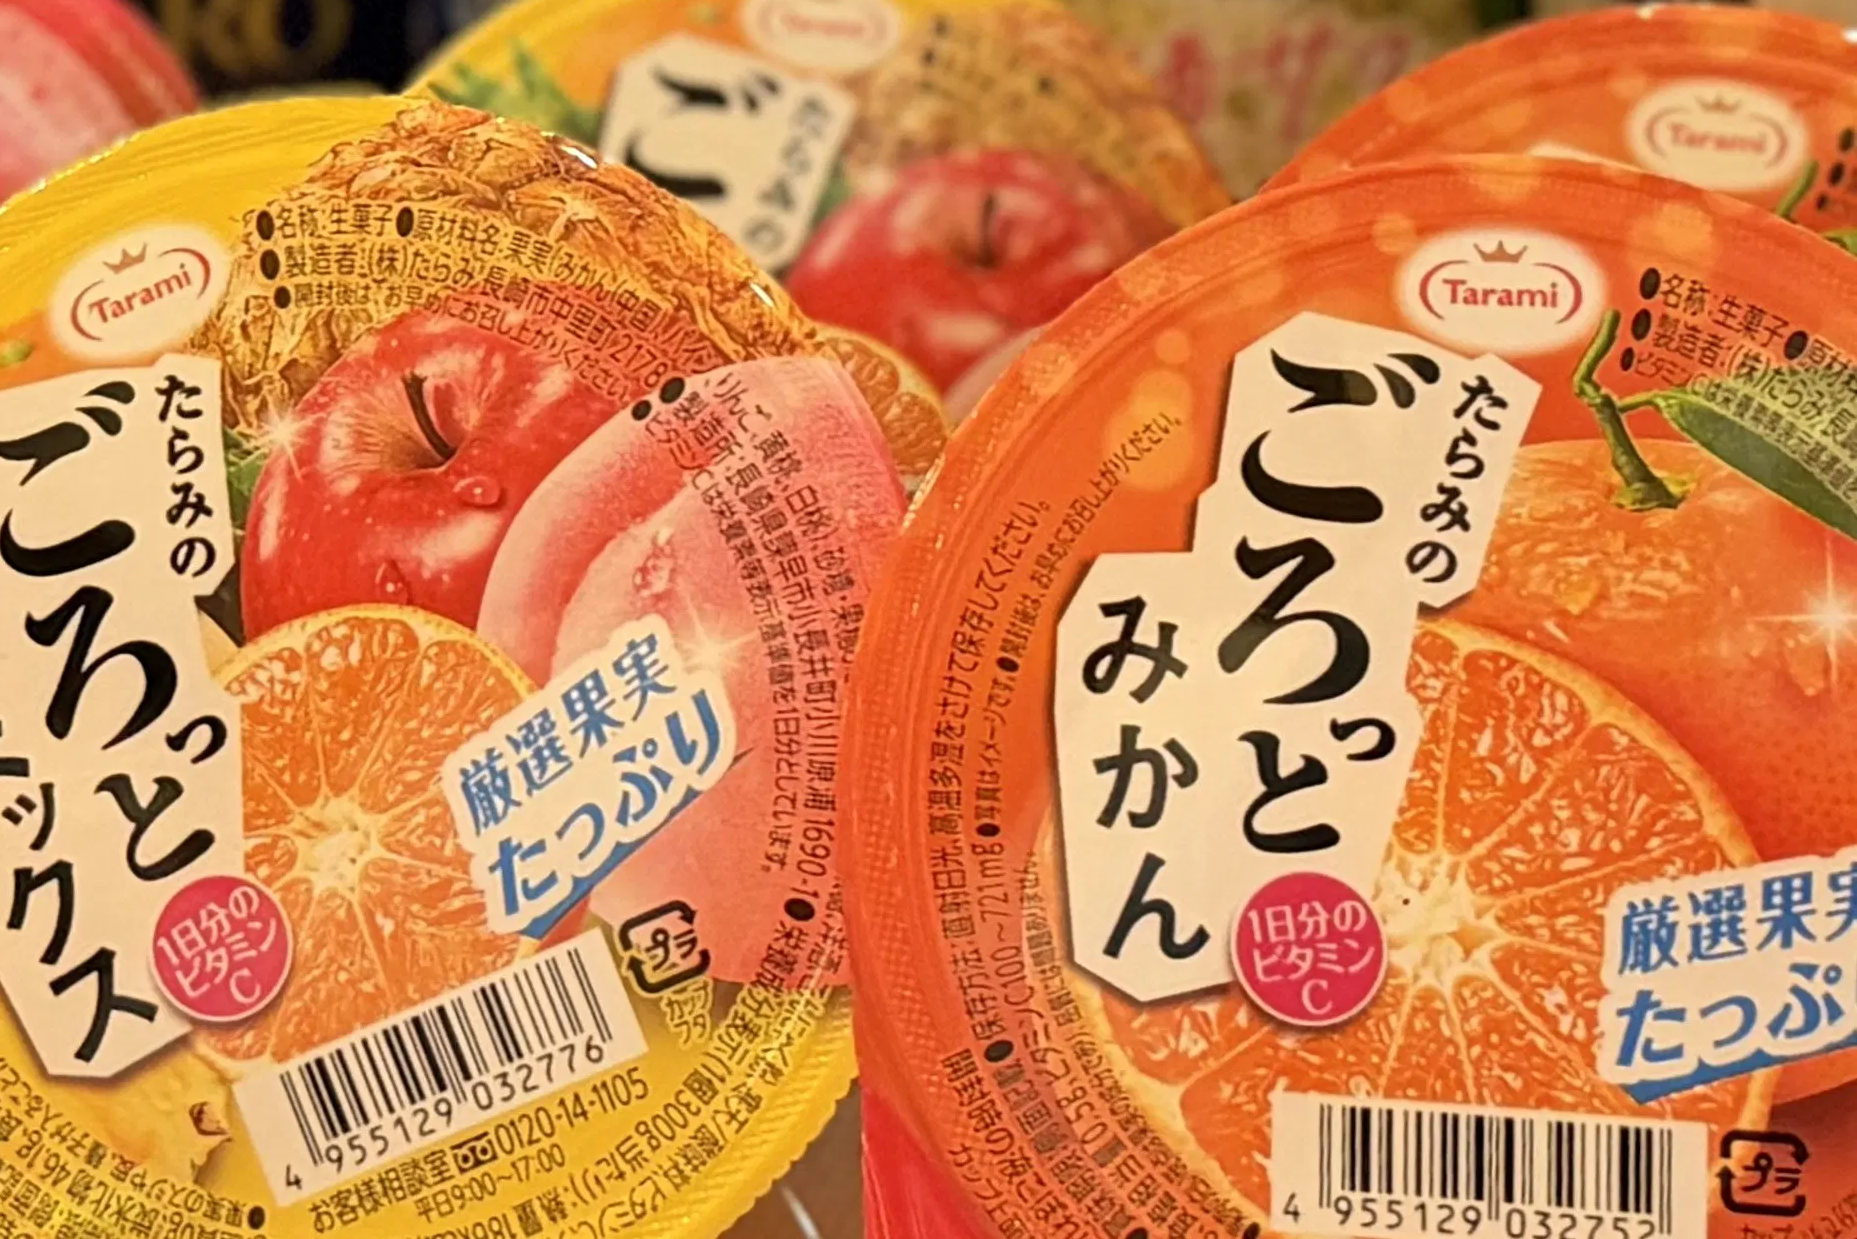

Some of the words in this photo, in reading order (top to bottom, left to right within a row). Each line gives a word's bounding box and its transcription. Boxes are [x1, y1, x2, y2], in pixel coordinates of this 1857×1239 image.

[1666, 119, 1768, 156] Tarami
[85, 264, 194, 327] Tarami
[1442, 276, 1560, 312] Tarami
[154, 373, 217, 580] たらみの
[1406, 372, 1509, 584] たらみの
[1217, 347, 1443, 854] ごろっと
[459, 632, 678, 836] 厳選果実
[489, 688, 724, 917] たっぷり
[1079, 595, 1212, 962] みかん
[155, 885, 261, 968] 1日分の
[173, 913, 278, 1001] ビタミン
[643, 926, 699, 973] プラ
[1247, 898, 1370, 945] 1日分の
[1251, 935, 1377, 987] ビタミン
[229, 969, 262, 1007] C
[1299, 976, 1333, 1017] C
[1615, 962, 1857, 1069] たっぷ
[283, 1163, 305, 1191] 4
[323, 1094, 456, 1176] 955129
[472, 1038, 606, 1114] 032776
[308, 1146, 455, 1235] お客様相談室
[494, 1066, 650, 1159] 0120-14-1105
[1280, 1191, 1303, 1224] 4
[1333, 1194, 1483, 1235] 955129
[1504, 1202, 1656, 1239] 032752
[1739, 1151, 1803, 1196] プラ
